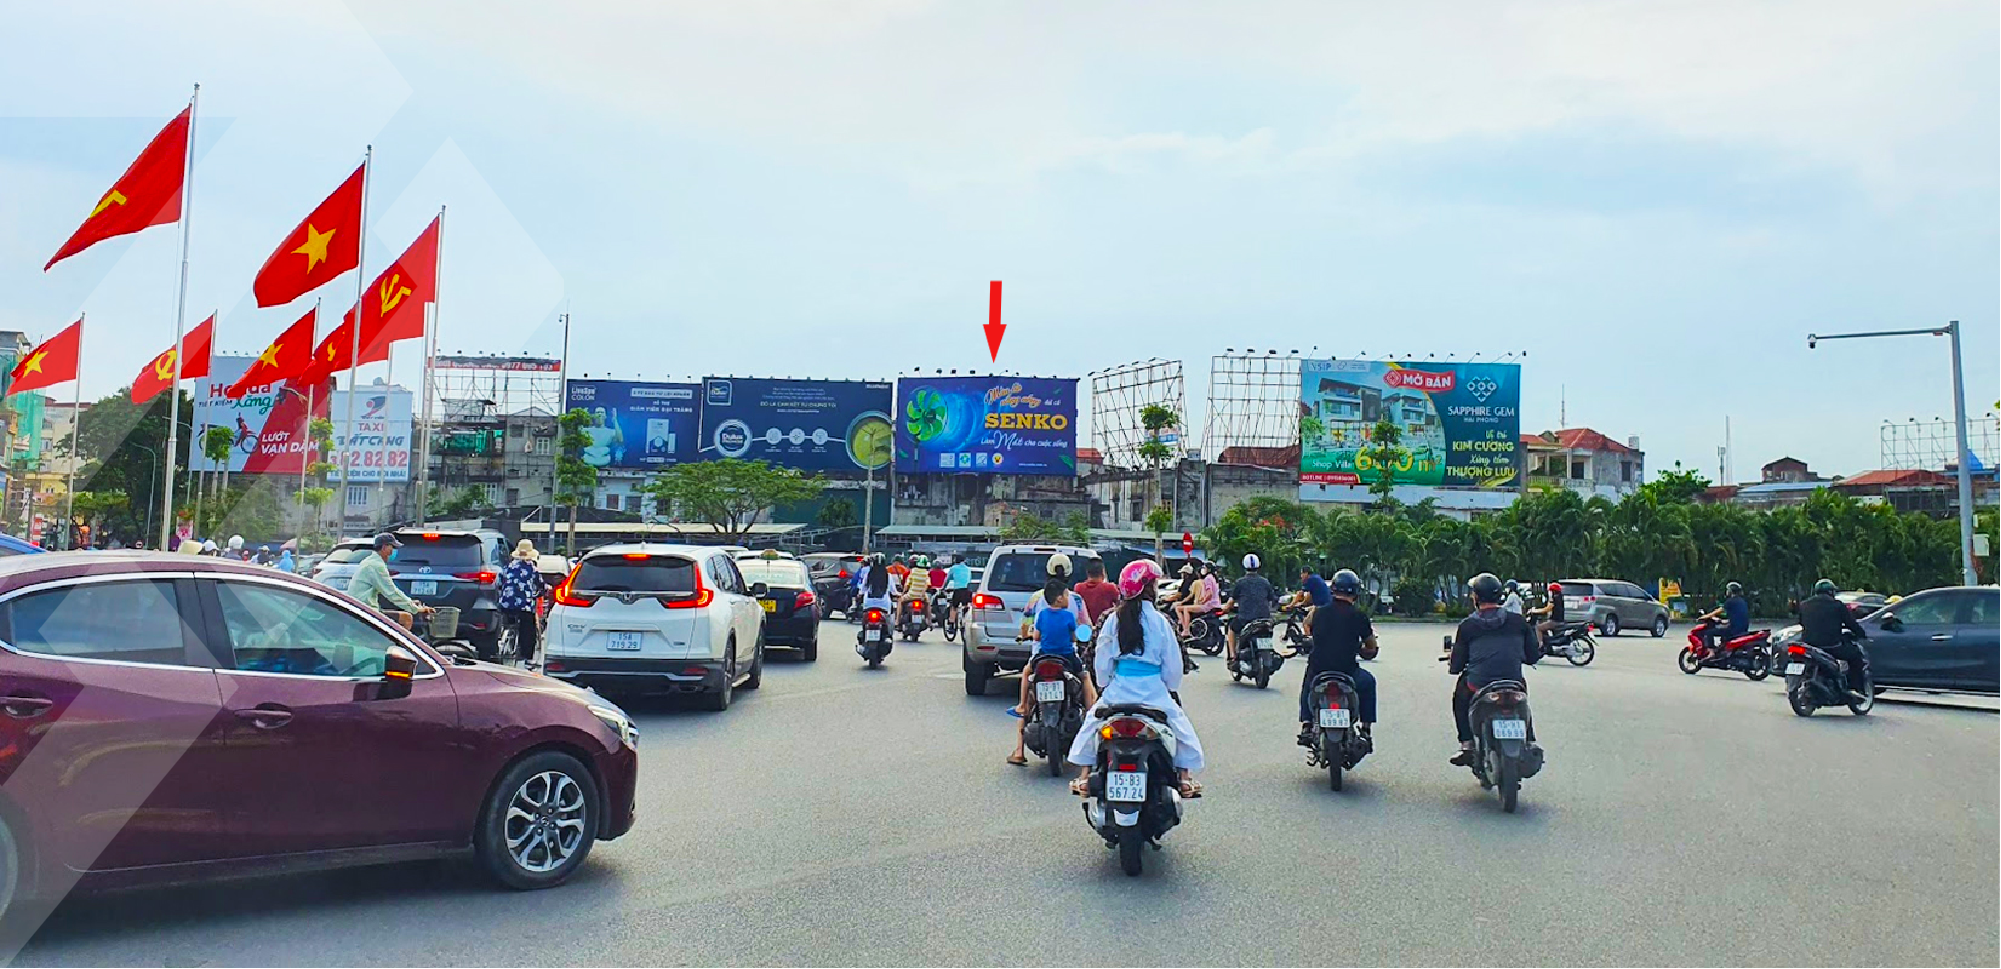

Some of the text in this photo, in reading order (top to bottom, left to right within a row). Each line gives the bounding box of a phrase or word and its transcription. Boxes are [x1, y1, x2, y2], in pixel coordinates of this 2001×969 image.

[1403, 373, 1451, 387] MỞ BÁN
[210, 383, 271, 397] Hda
[1447, 406, 1515, 417] SAPPHIRE GEM
[358, 423, 384, 431] TAXI
[984, 412, 1068, 430] SENKO
[1452, 440, 1472, 452] KIM
[1113, 773, 1141, 786] 15-B3
[1108, 786, 1144, 799] 567.24
